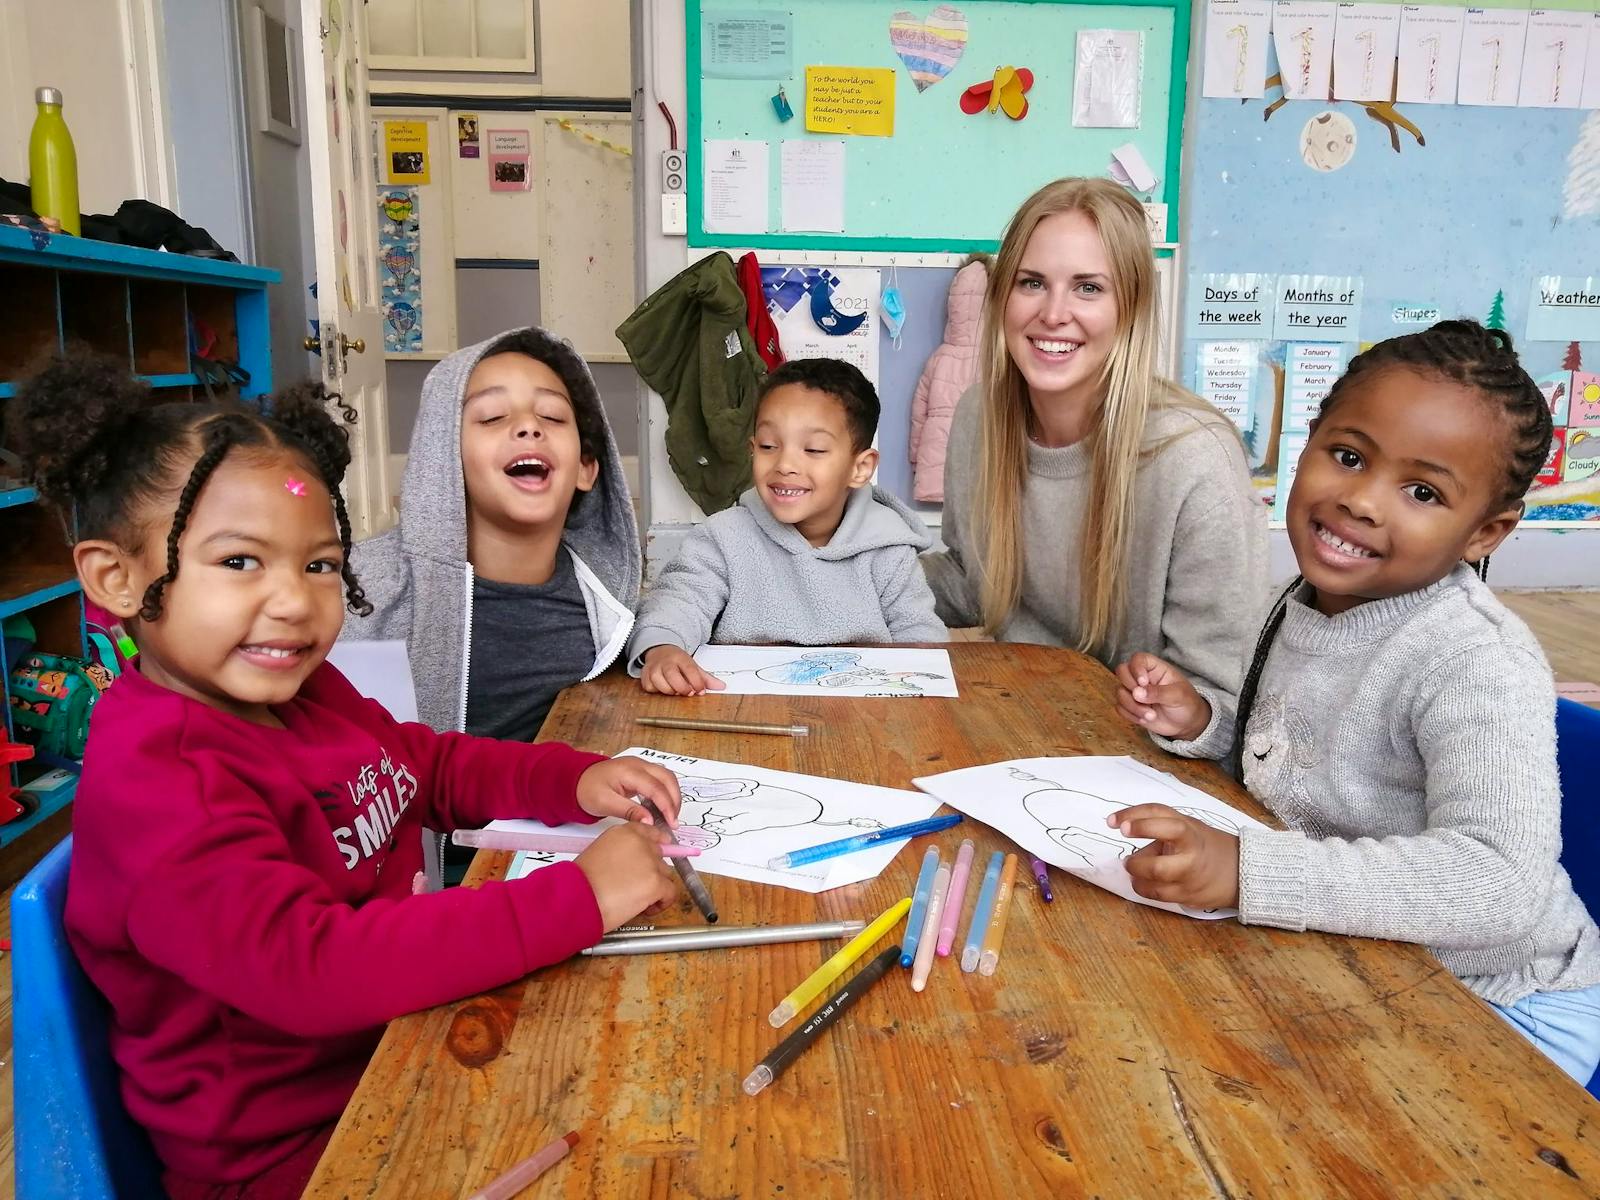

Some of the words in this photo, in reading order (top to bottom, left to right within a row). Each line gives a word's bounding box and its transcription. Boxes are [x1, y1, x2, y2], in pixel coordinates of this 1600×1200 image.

[840, 87, 855, 95] just
[1204, 287, 1238, 303] Days
[1244, 287, 1259, 300] of
[1284, 289, 1334, 302] Months
[1340, 290, 1355, 303] of
[1541, 290, 1600, 304] Weather
[834, 297, 869, 310] 2021
[1199, 310, 1222, 322] the
[1228, 310, 1262, 322] week
[1288, 312, 1311, 324] the
[1317, 314, 1347, 327] year
[1207, 369, 1246, 377] Wednesday
[1300, 363, 1333, 371] February
[1210, 382, 1242, 390] Thursday
[1306, 391, 1323, 399] April
[1306, 406, 1321, 414] May
[1568, 460, 1599, 471] Cloudy
[380, 746, 396, 776] of
[332, 762, 418, 870] SMILES
